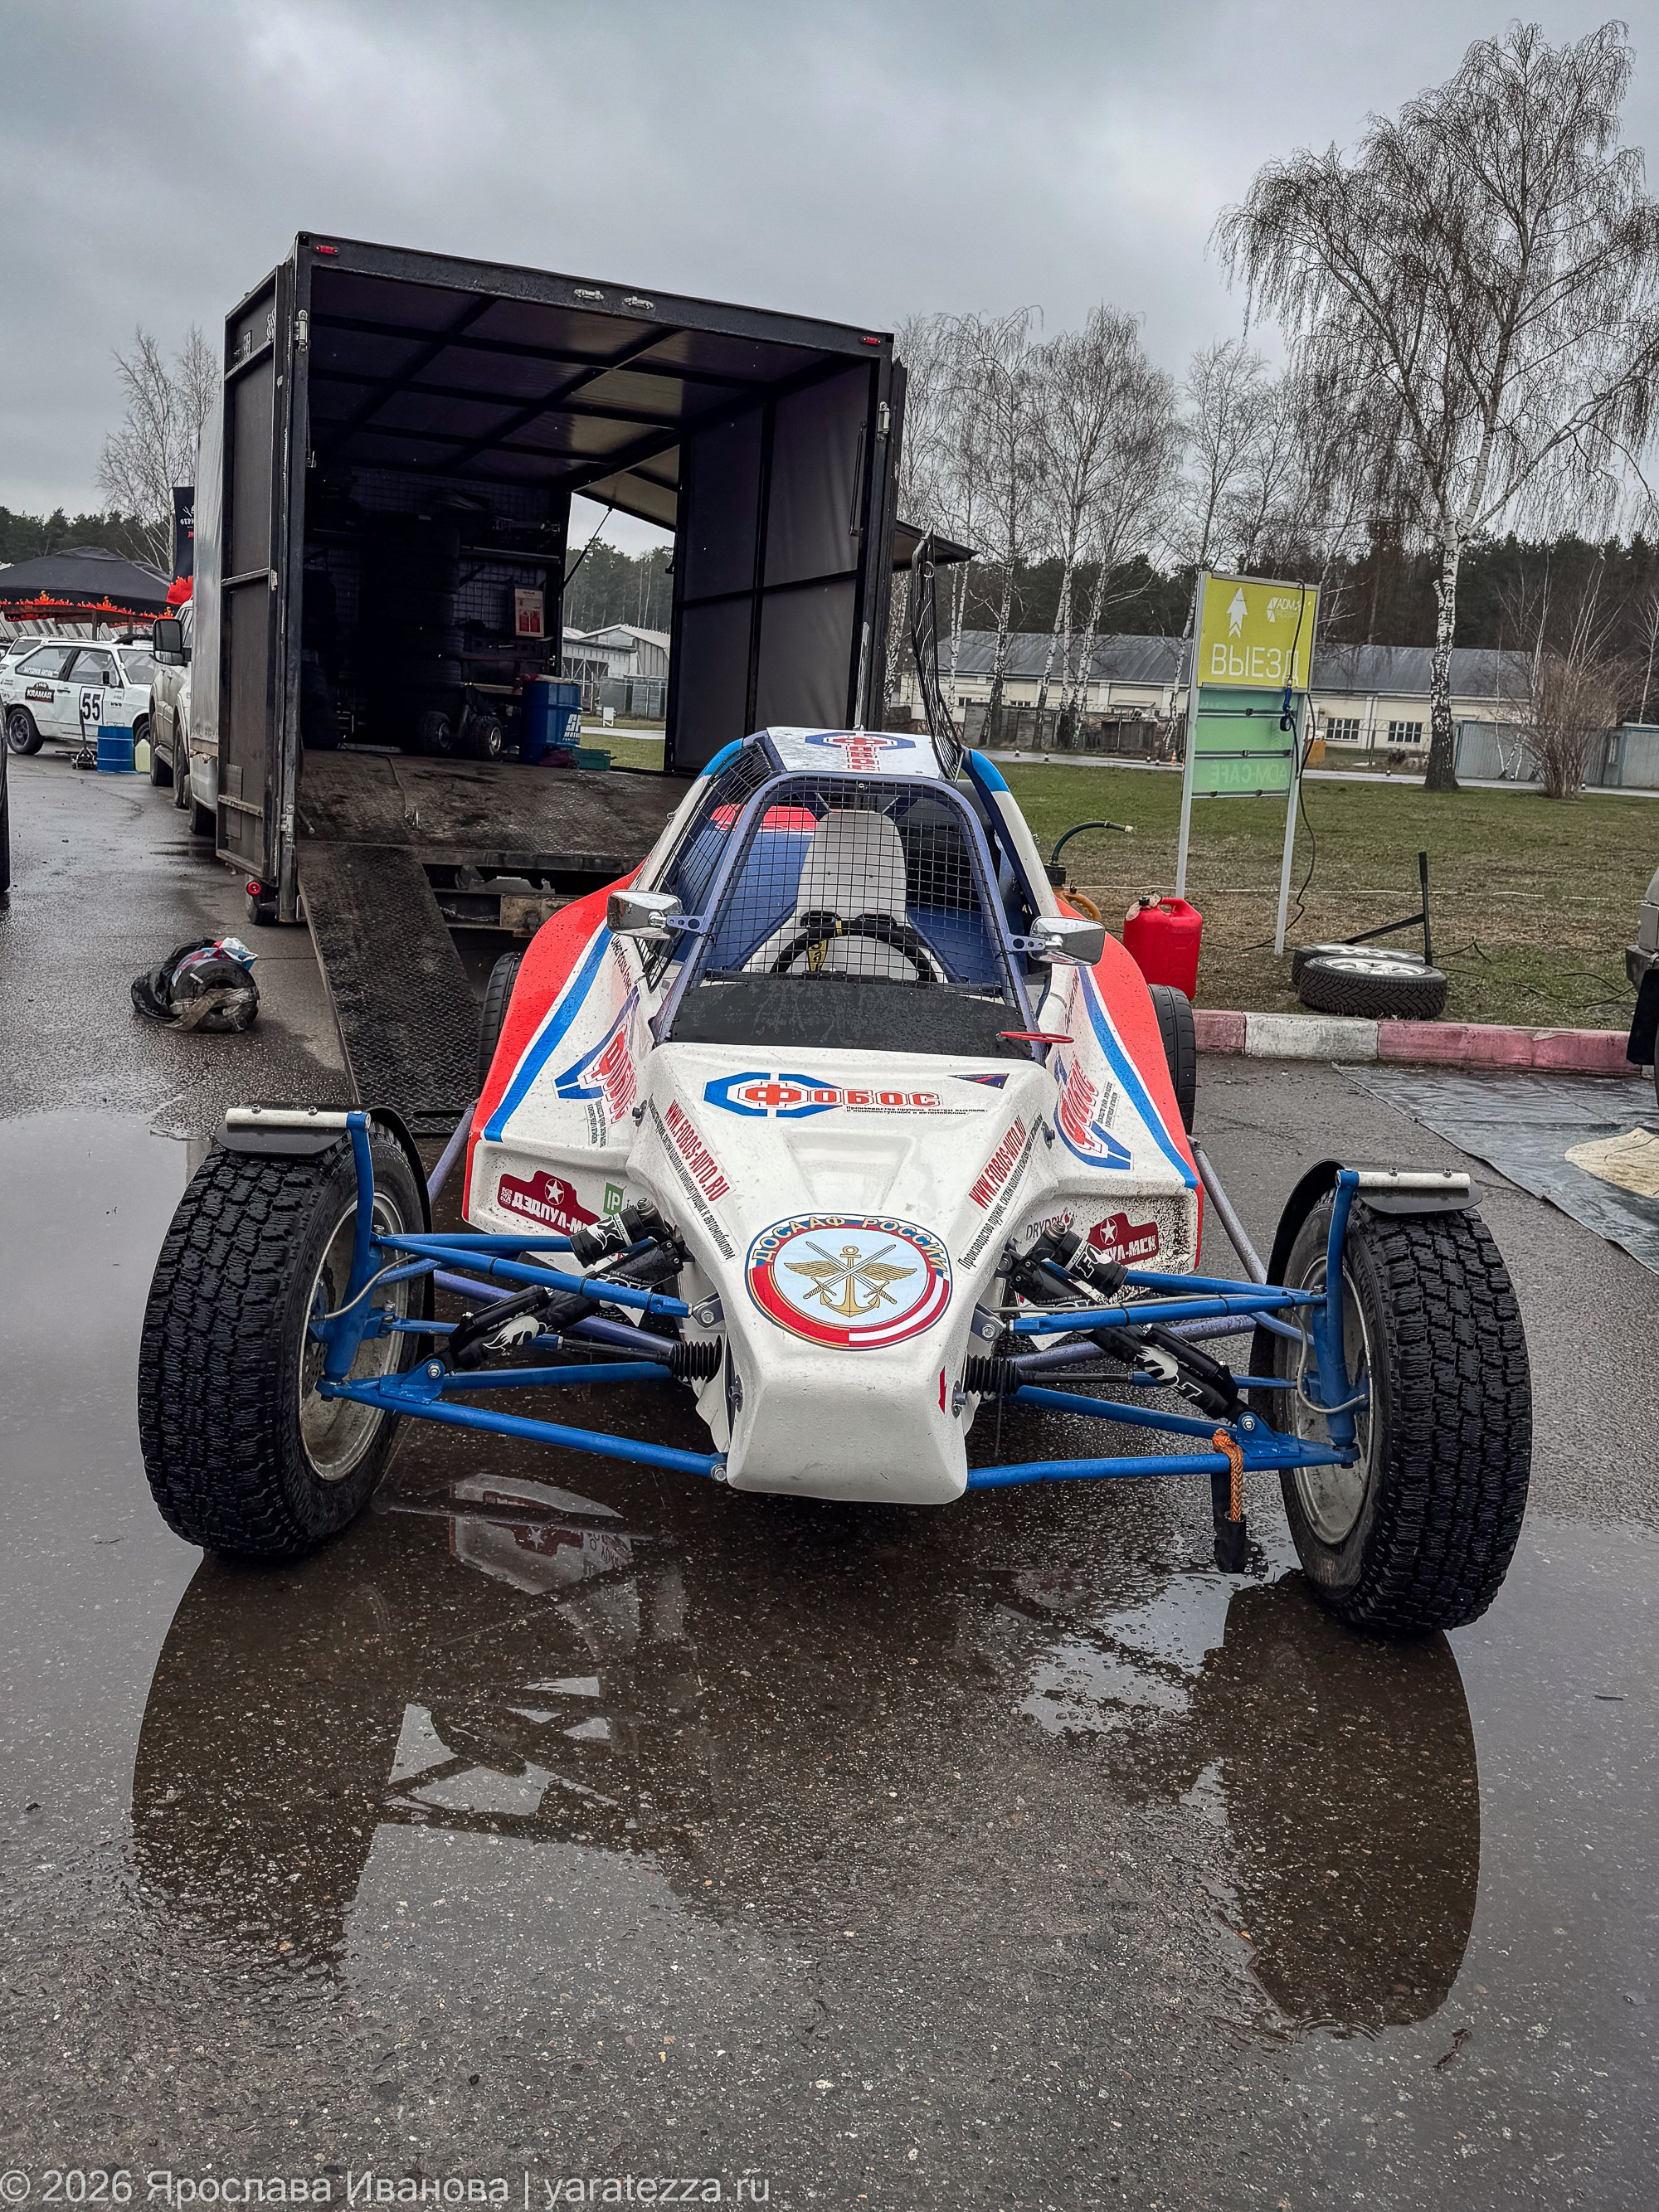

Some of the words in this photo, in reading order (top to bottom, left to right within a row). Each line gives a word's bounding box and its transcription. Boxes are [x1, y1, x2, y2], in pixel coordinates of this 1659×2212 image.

[1210, 643, 1300, 687] ВЫЕЗД
[82, 693, 100, 721] 55
[738, 1081, 941, 1109] ФОБОС
[664, 1099, 731, 1202] WWW.FOBOS-AVTO.RU
[968, 1115, 1027, 1210] WWW.FOBOS-AVTO.RU
[511, 1191, 591, 1234] ДЭДПУЛ-М
[606, 1190, 621, 1211] IP
[703, 1214, 736, 1261] автомобилям
[752, 1216, 845, 1263] ДОСААФ
[861, 1217, 948, 1273] РОССИИ
[957, 1222, 995, 1270] Производство
